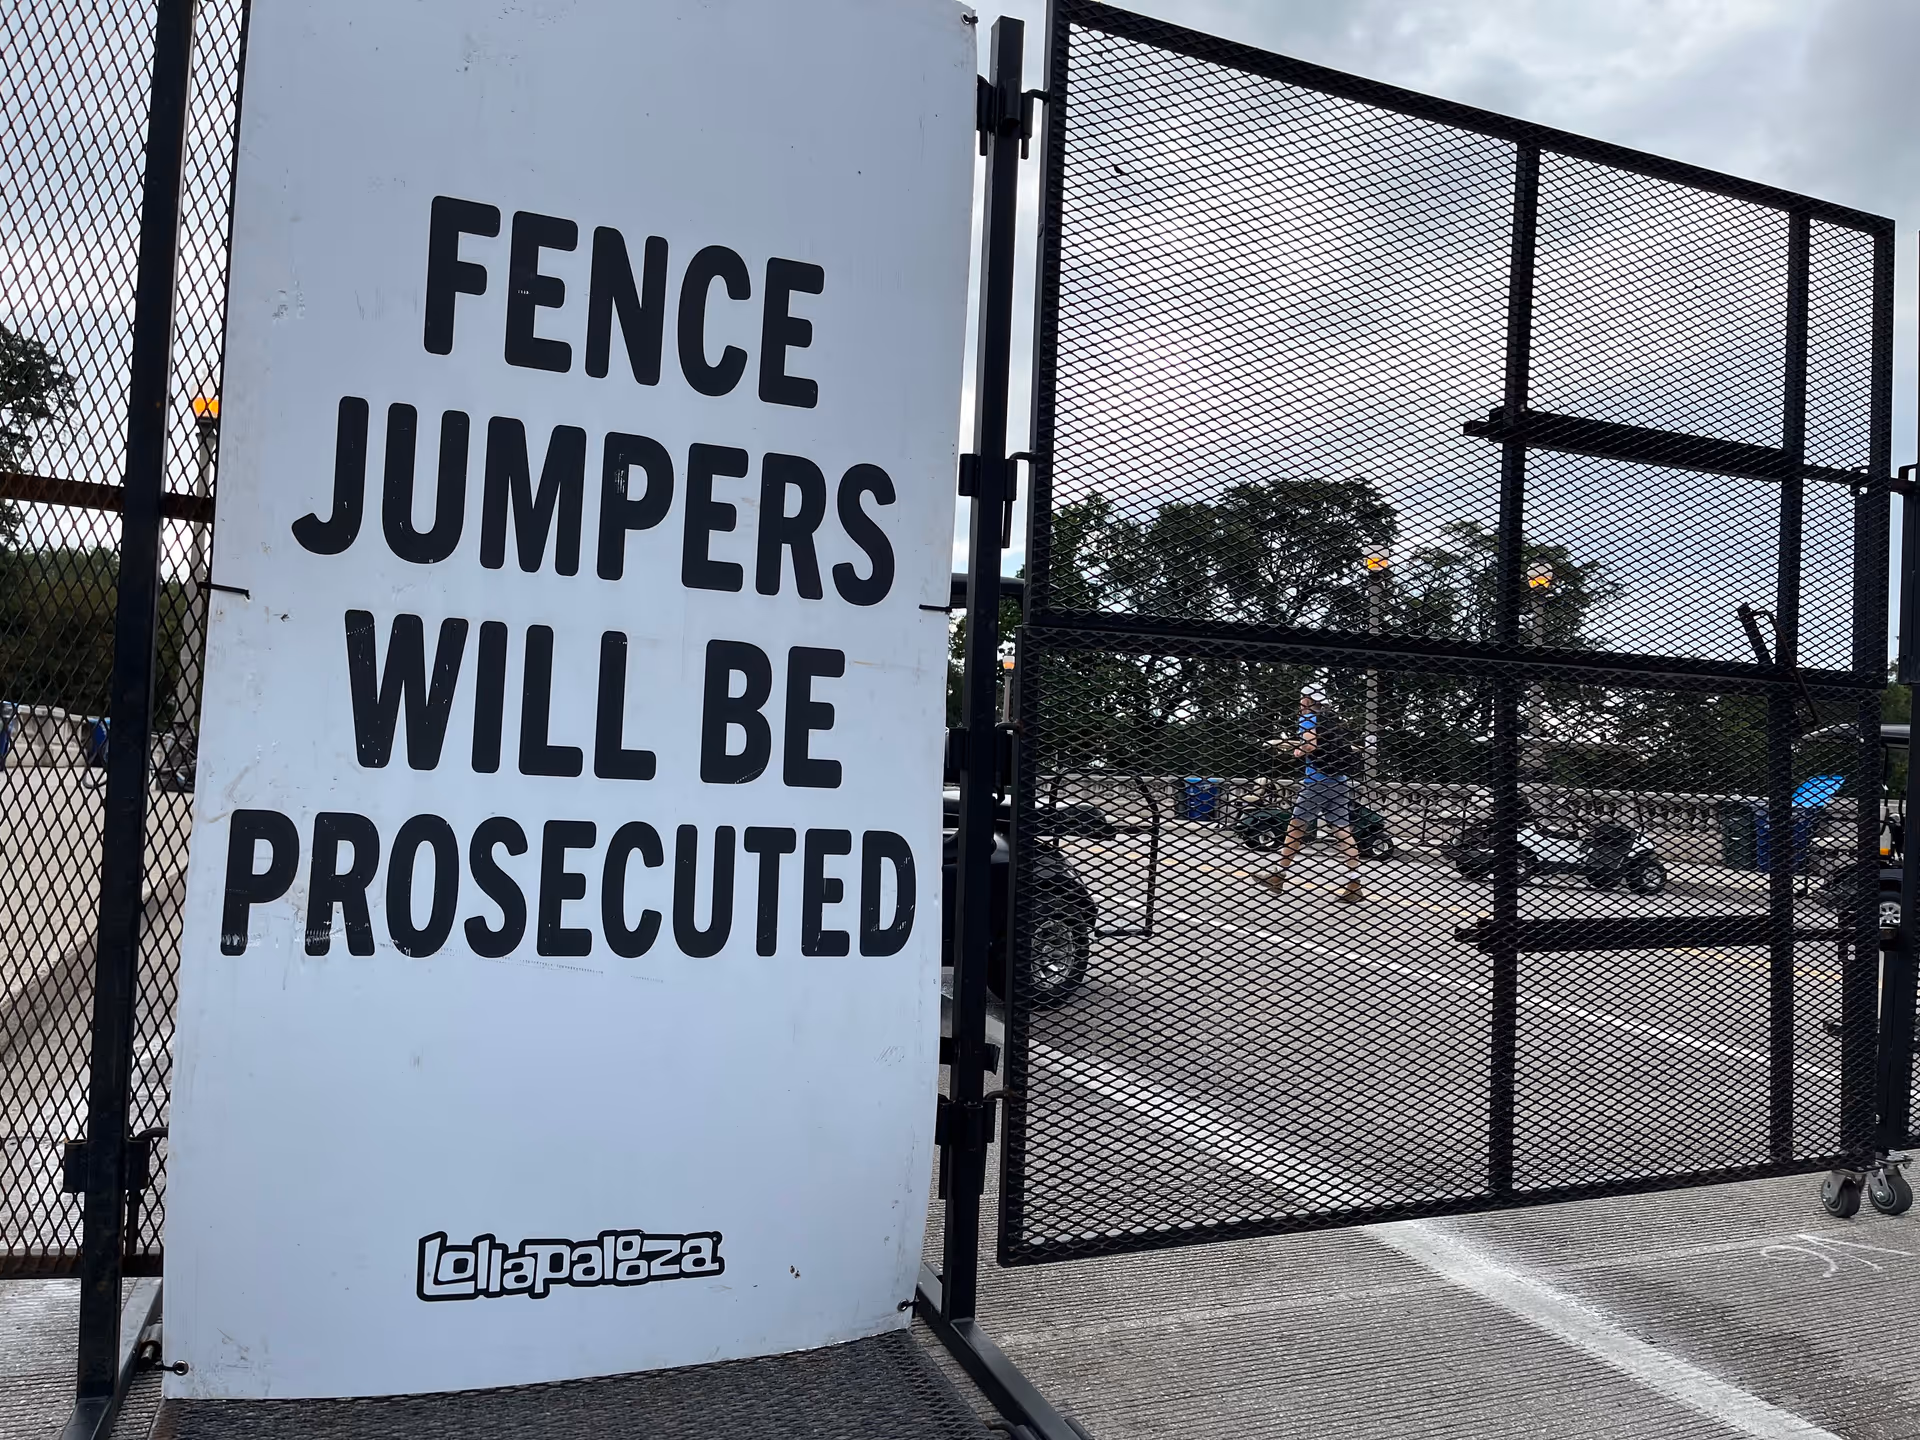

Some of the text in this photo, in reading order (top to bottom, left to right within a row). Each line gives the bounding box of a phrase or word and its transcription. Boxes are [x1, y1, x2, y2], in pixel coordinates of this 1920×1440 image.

[424, 195, 825, 408] FENCE
[292, 396, 897, 606] JUMPERS
[345, 609, 846, 789] WILL BE
[220, 808, 917, 959] PROSECUTED
